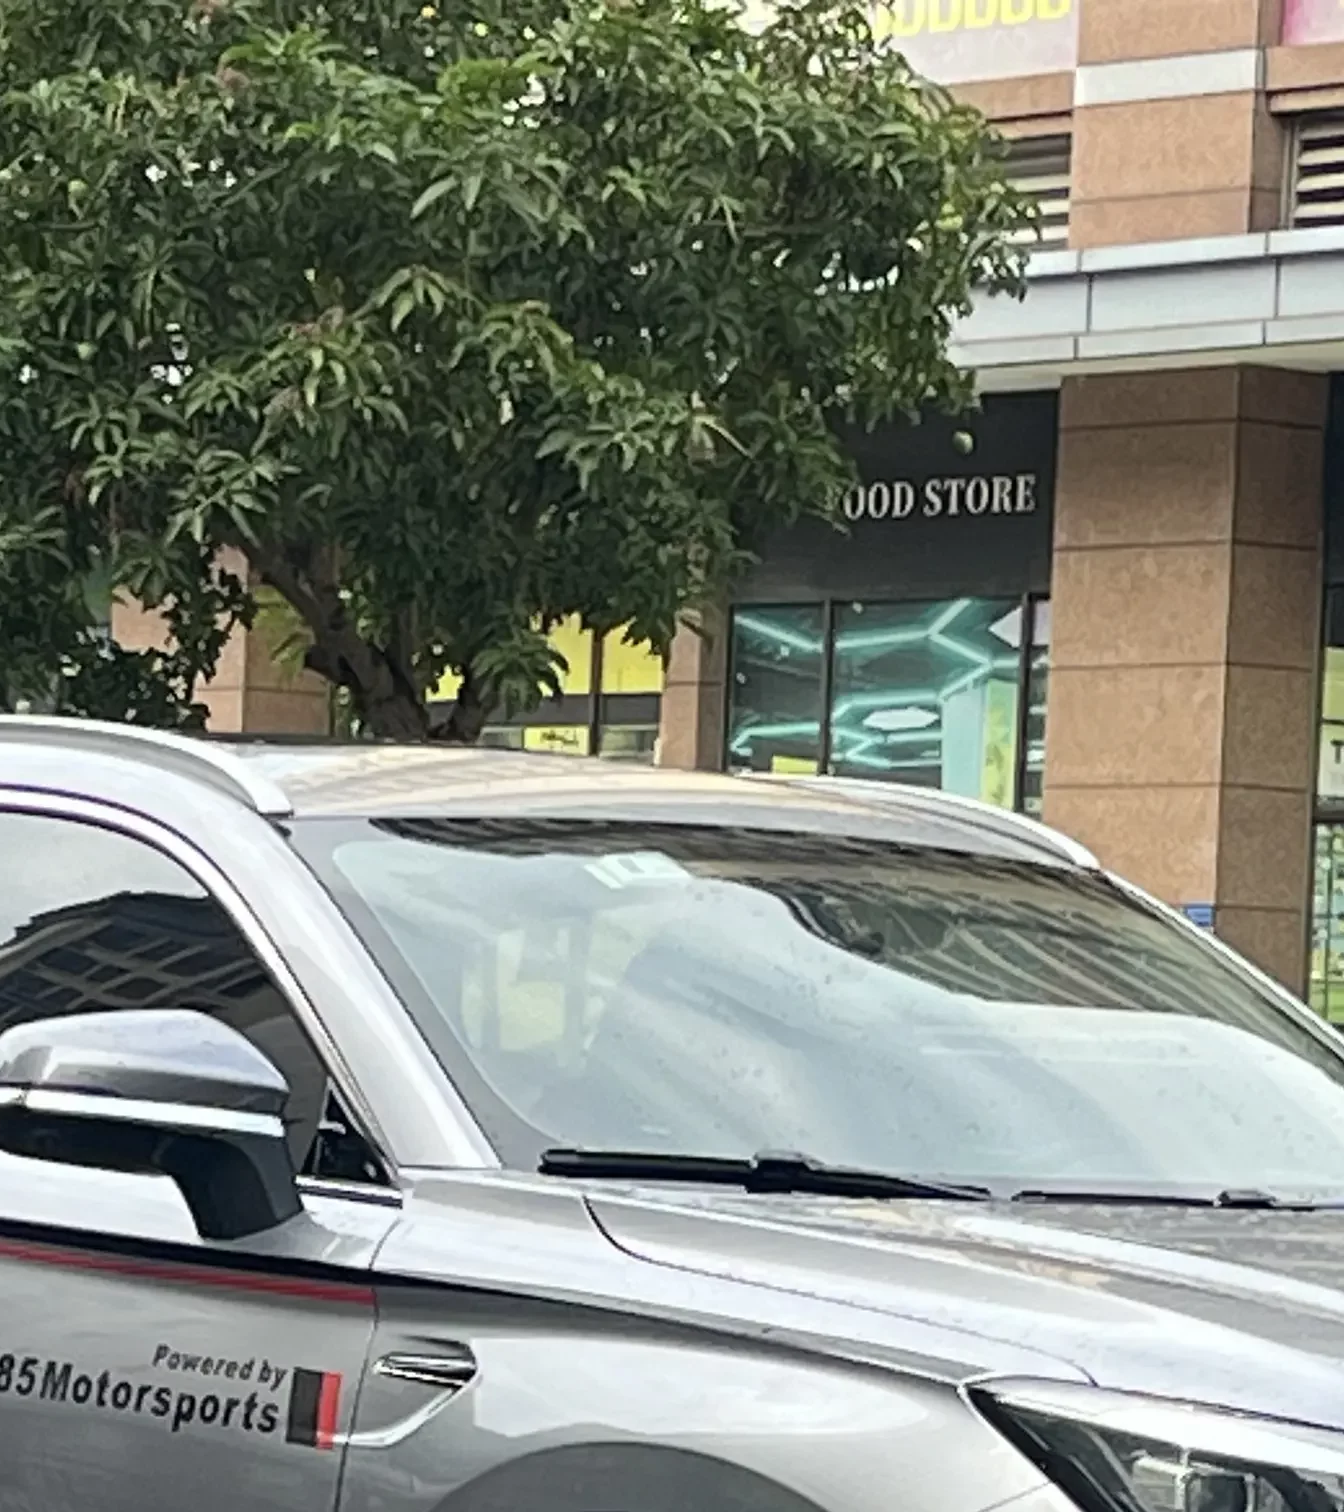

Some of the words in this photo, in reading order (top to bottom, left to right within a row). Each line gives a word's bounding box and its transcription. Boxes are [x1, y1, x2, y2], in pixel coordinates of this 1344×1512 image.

[836, 480, 915, 520] OOD
[923, 474, 1036, 517] STORE
[152, 1344, 255, 1380] Powered
[257, 1360, 287, 1392] by
